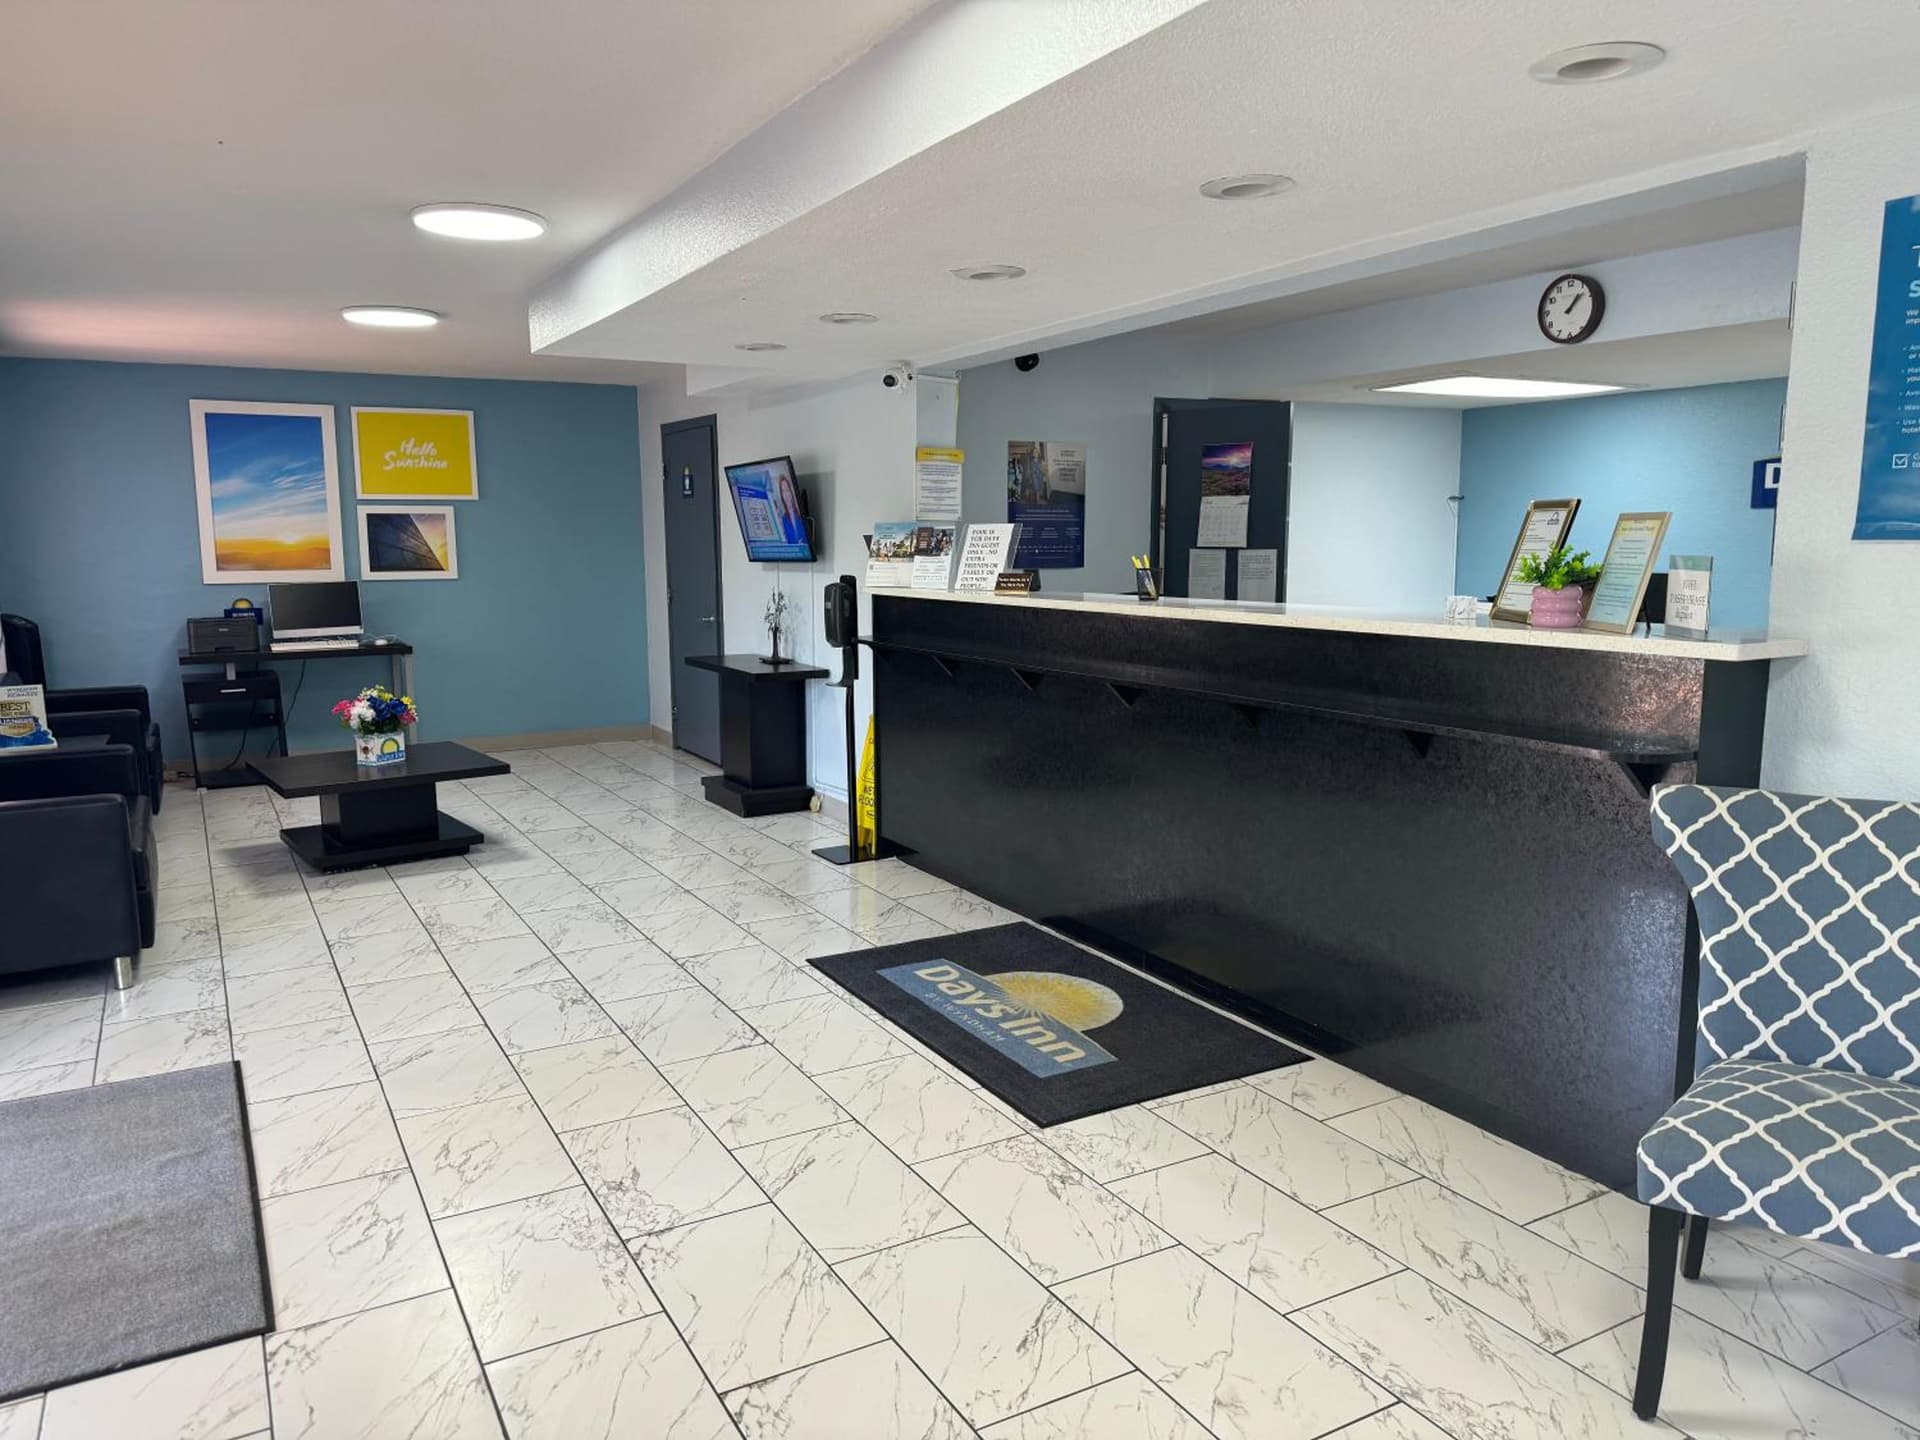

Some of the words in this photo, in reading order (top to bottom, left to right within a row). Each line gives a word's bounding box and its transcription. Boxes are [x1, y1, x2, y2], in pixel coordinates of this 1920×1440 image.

[1549, 296, 1556, 304] 10
[400, 437, 437, 456] Hello
[383, 450, 449, 471] Sunshine
[0, 701, 31, 712] BEST
[913, 964, 1017, 1018] Days
[999, 1016, 1087, 1064] Inn
